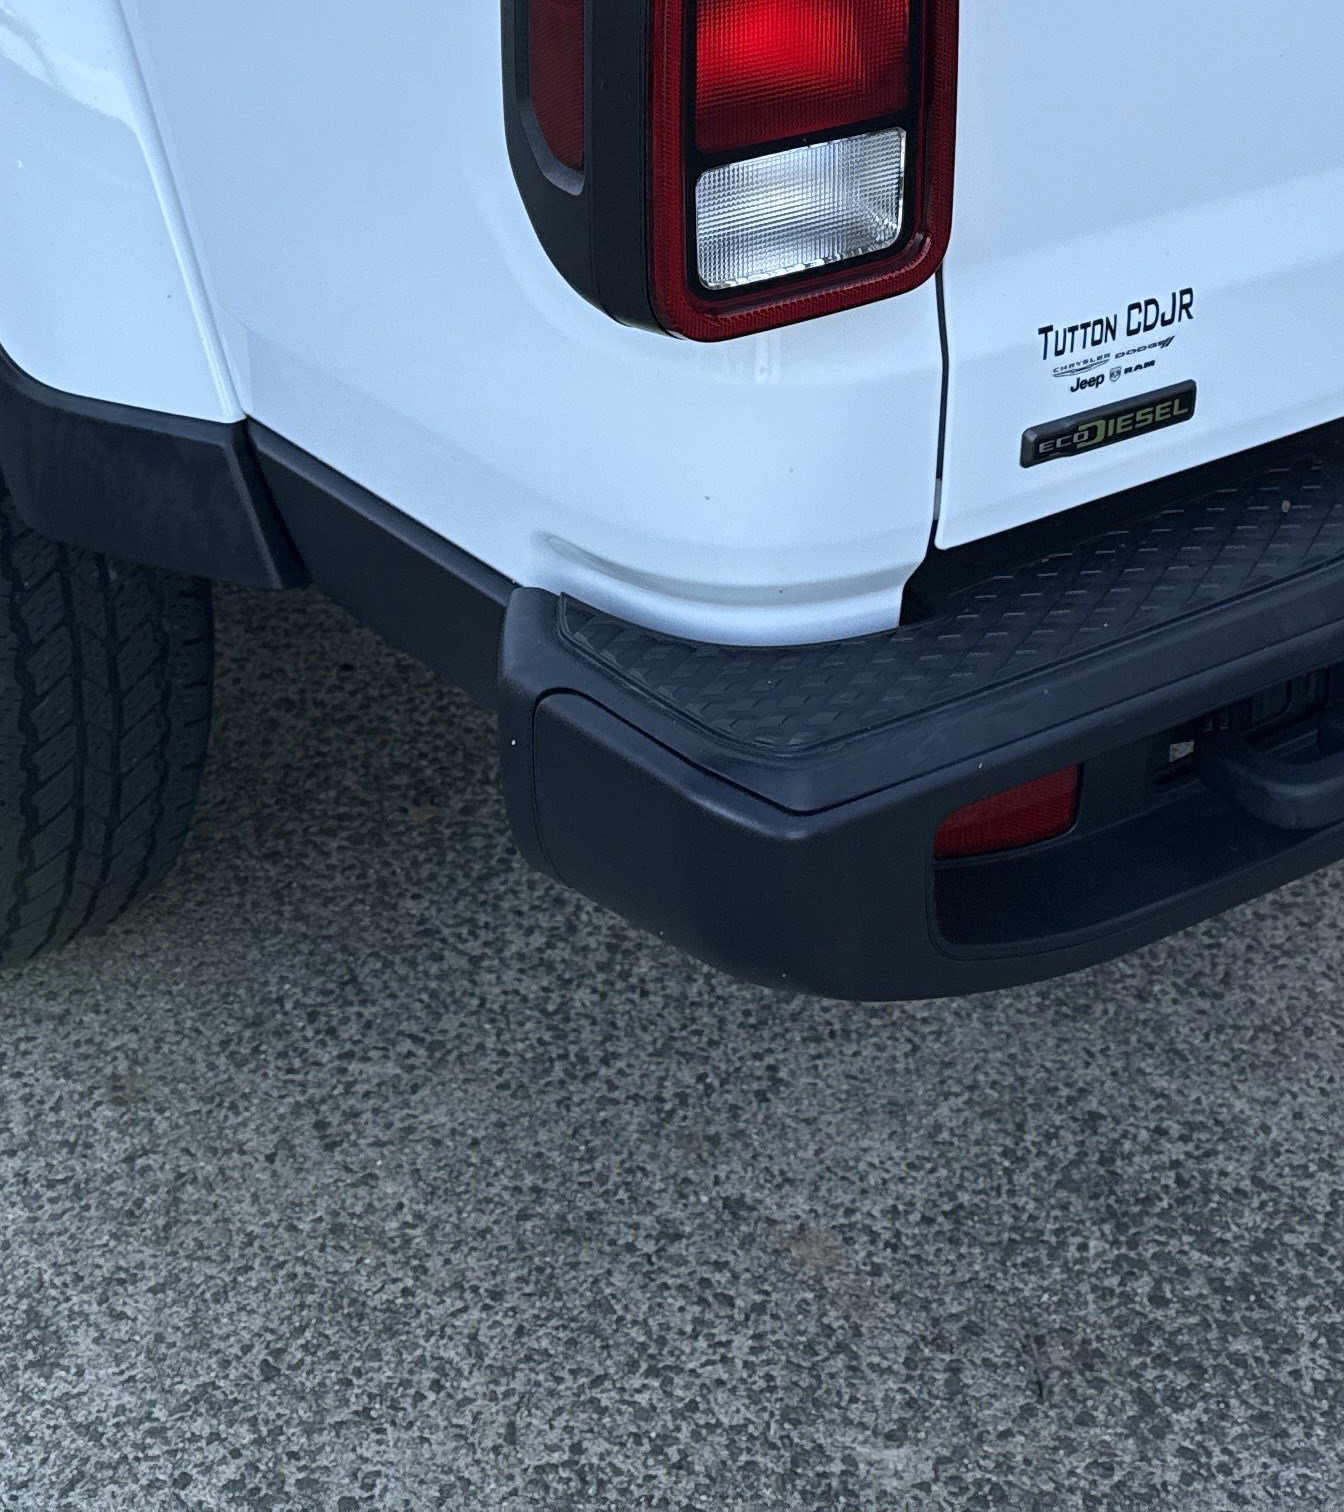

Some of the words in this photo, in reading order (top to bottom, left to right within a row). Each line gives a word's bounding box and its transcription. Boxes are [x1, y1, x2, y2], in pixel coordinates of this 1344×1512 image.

[1037, 313, 1118, 360] TUTTON
[1126, 287, 1194, 337] CDJR
[1053, 353, 1111, 373] CHRYSLER
[1070, 373, 1105, 393] Jeep
[1124, 360, 1156, 375] RAM
